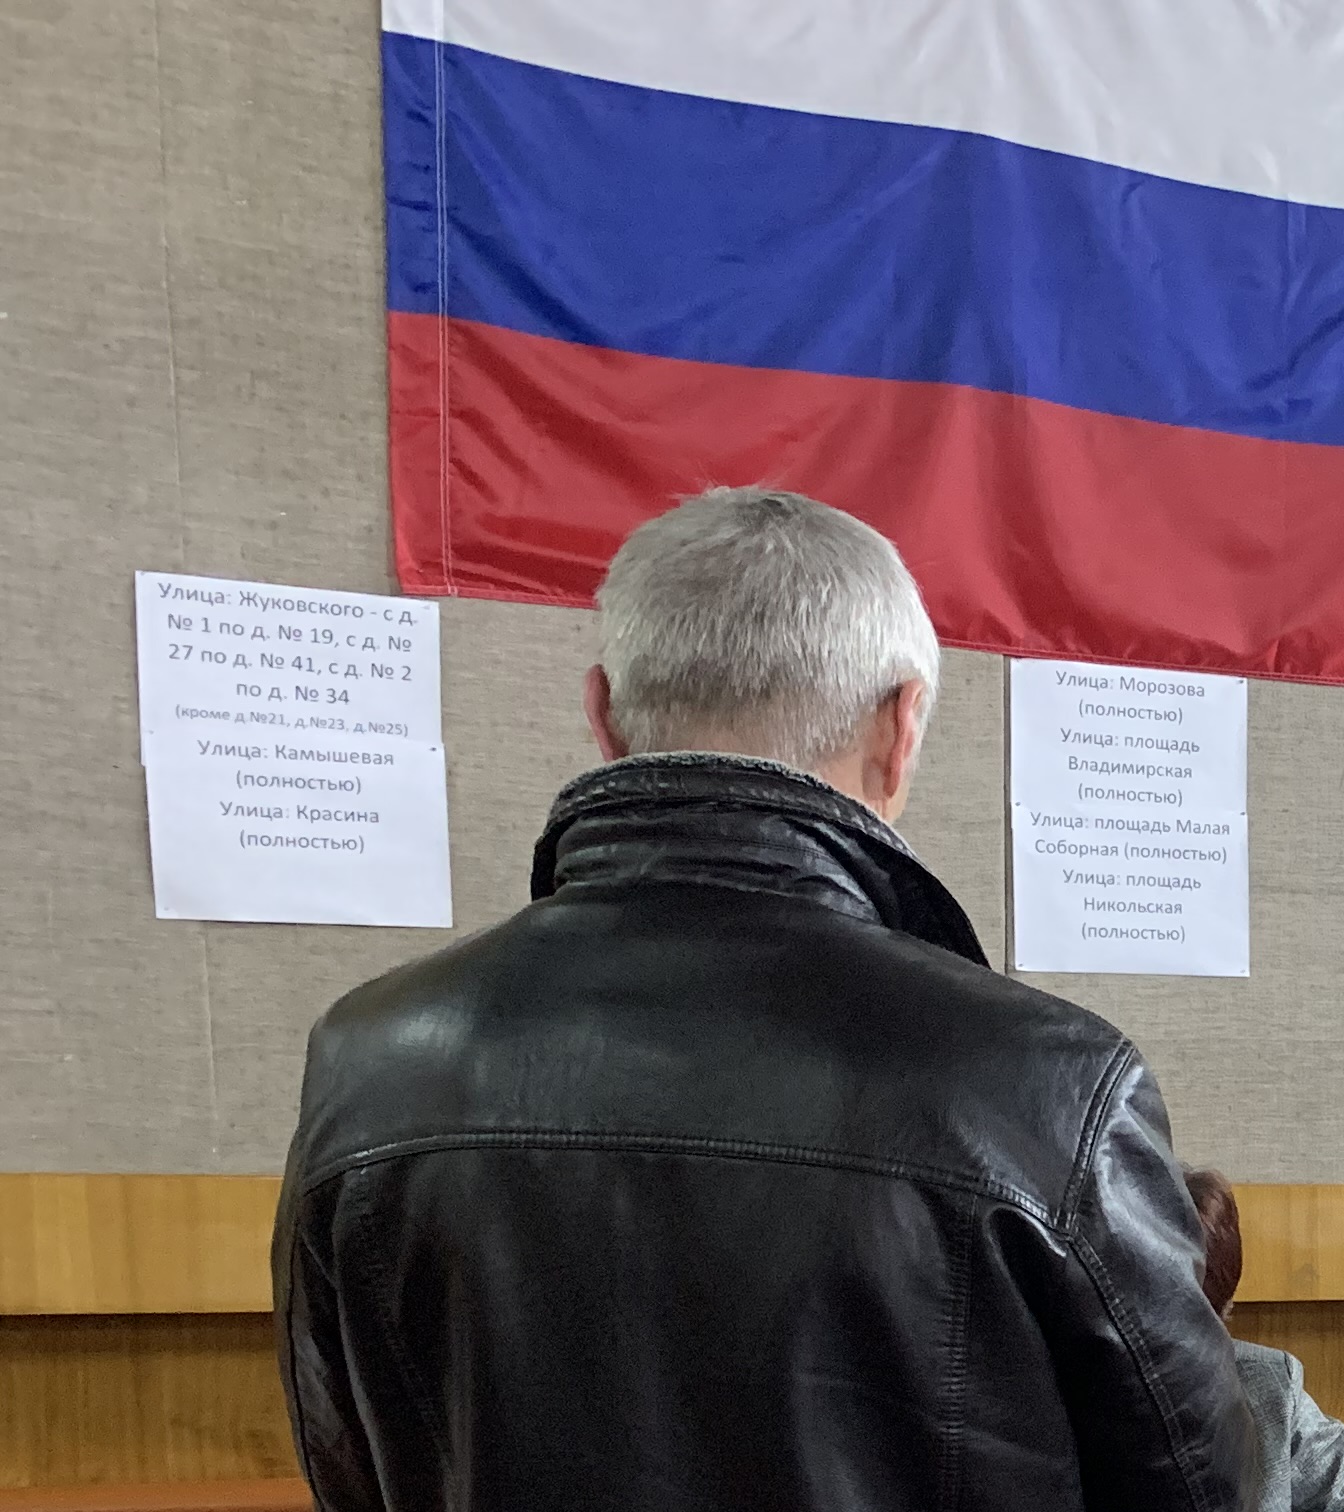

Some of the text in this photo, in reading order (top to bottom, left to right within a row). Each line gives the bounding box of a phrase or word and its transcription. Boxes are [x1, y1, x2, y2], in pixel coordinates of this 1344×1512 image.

[158, 583, 231, 605] Улица:
[239, 591, 364, 618] Жуковского
[383, 609, 394, 621] с
[399, 609, 418, 626] д.
[168, 614, 412, 652] № 1 по д. № 19, с д. №
[168, 644, 412, 681] 27 по д. № 41, с д. № 2
[236, 683, 350, 704] по д. № 34
[1055, 670, 1205, 698] Улица: Морозова
[175, 705, 230, 721] (кроме
[1078, 699, 1183, 724] (полностью)
[197, 739, 394, 766] Улица: Камышевая
[1060, 728, 1200, 753] Улица: площадь
[1068, 756, 1192, 778] Владимирская
[236, 769, 362, 794] (полностью)
[1078, 783, 1183, 806] (полностью)
[219, 801, 379, 824] Улица: Красина
[1030, 812, 1230, 836] Улица: площадь Малая
[239, 830, 365, 853] (полностью)
[1035, 839, 1227, 864] Соборная (полностью)
[1062, 869, 1202, 890] Улица: площадь
[1083, 897, 1182, 915] Никольская
[1081, 923, 1186, 943] (полностью)
